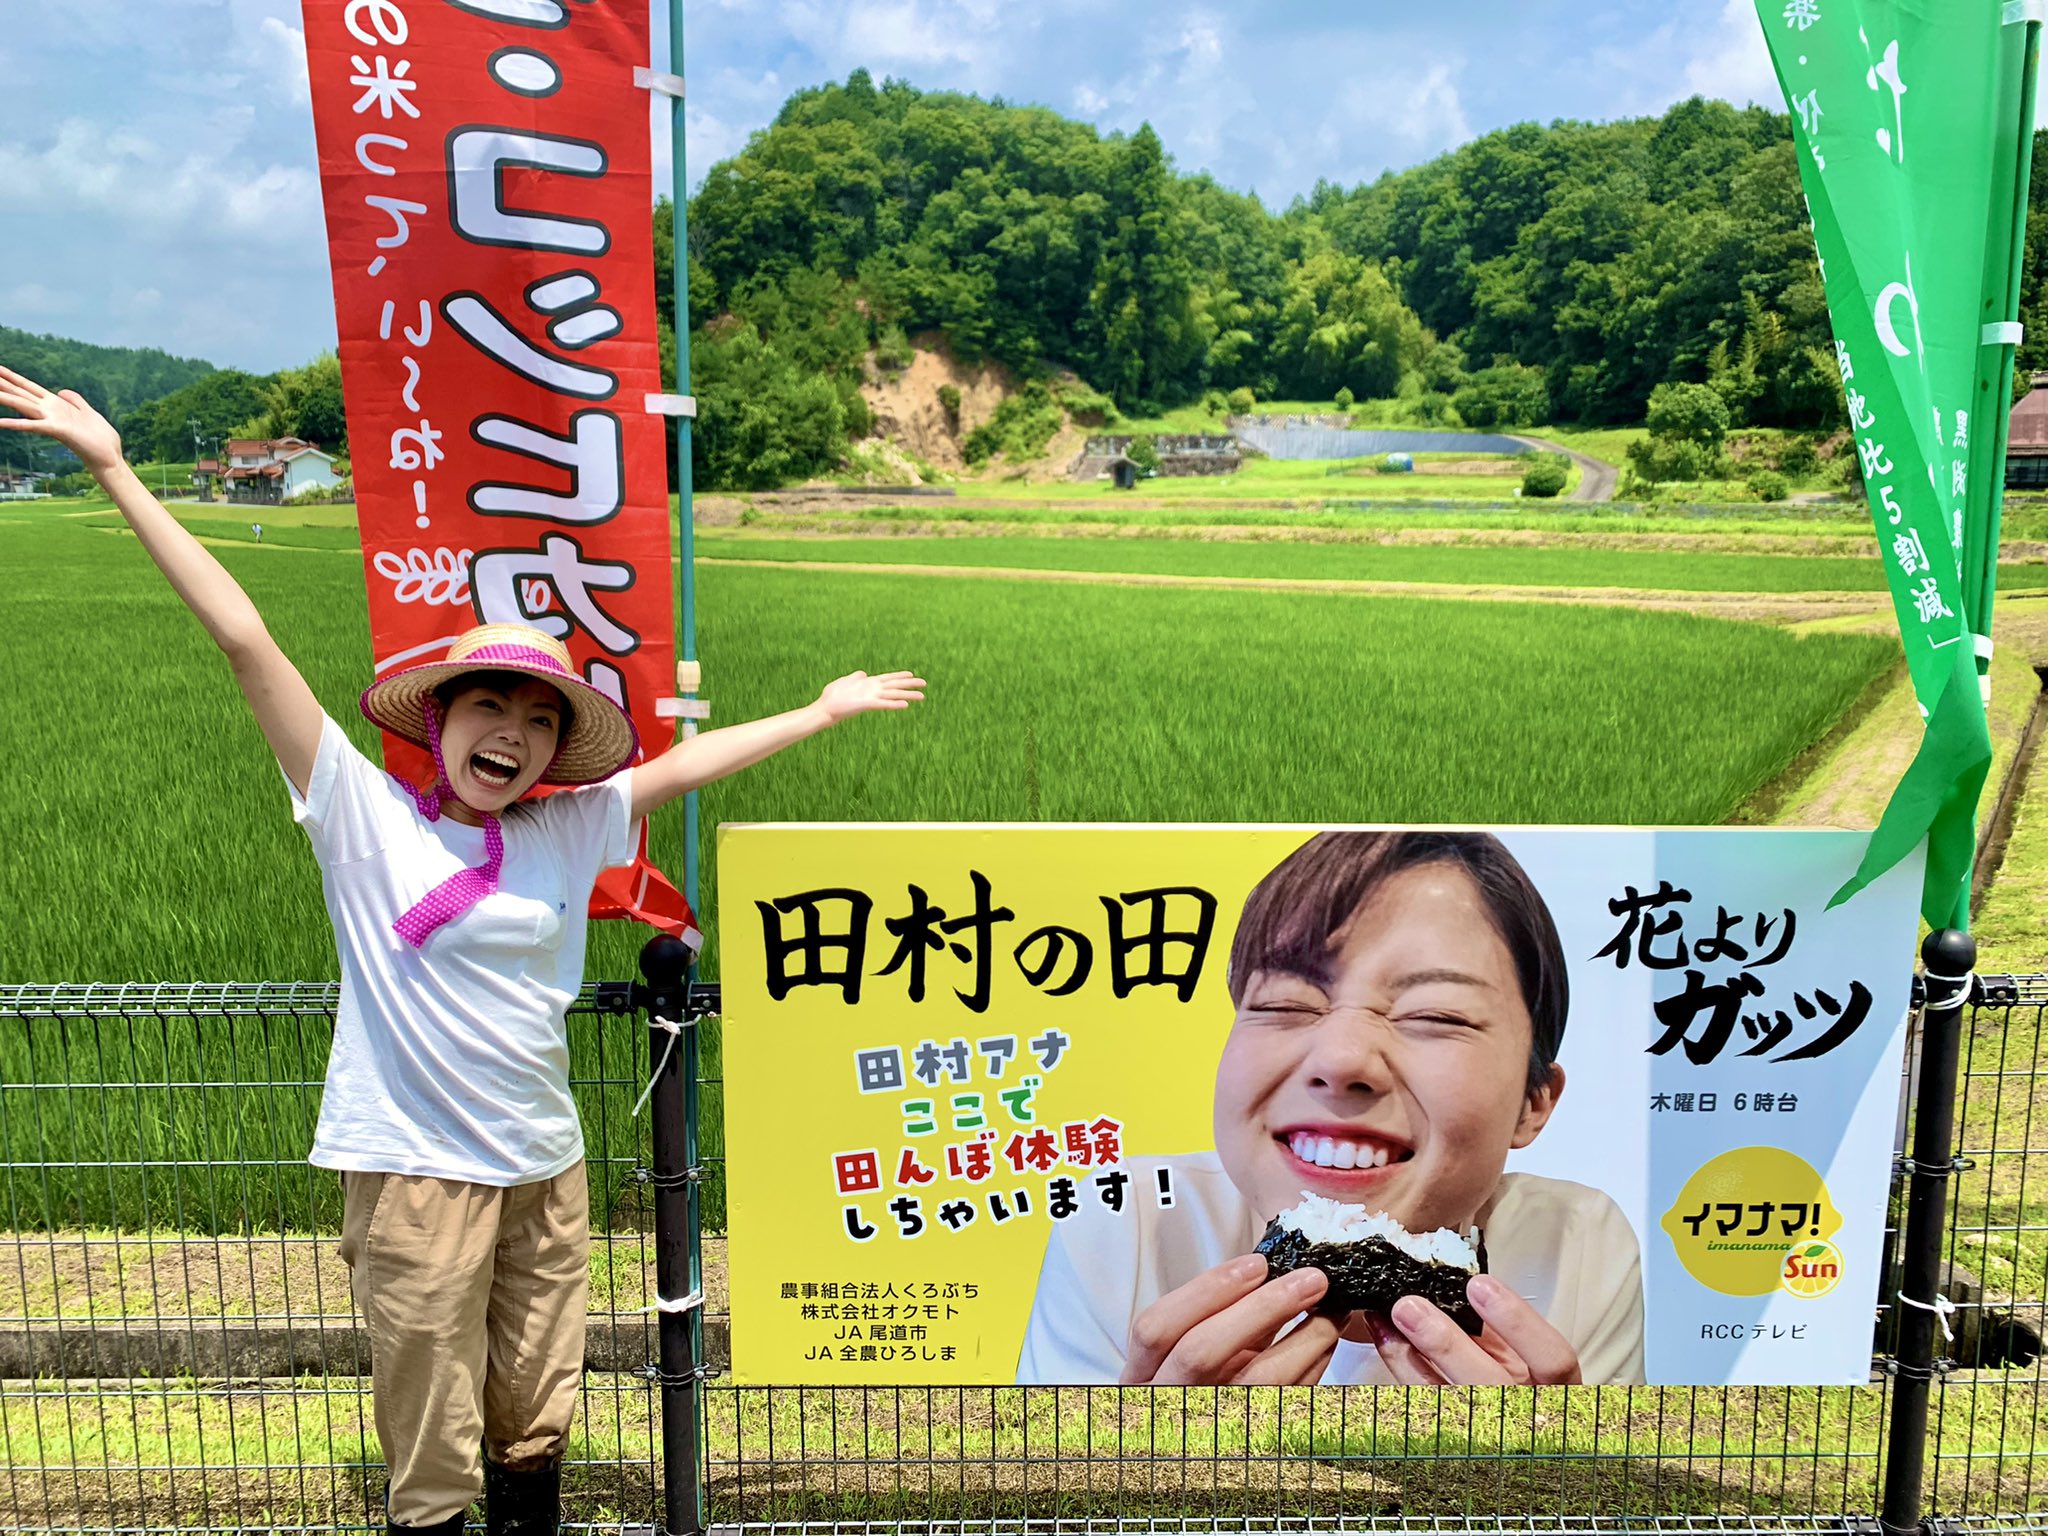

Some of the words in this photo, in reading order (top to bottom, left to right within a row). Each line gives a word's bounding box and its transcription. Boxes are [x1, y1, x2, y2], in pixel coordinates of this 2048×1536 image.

[1587, 880, 1797, 970] 花より
[754, 869, 1218, 1014] 田村の田
[1644, 969, 1873, 1066] ガッツ
[855, 1030, 1070, 1091] 田村アナ
[903, 1078, 1039, 1134] ここで
[1649, 1092, 1717, 1113] 木曜日
[1733, 1092, 1799, 1113] 6時台
[834, 1118, 1125, 1194] 田んぼ体験
[845, 1168, 1175, 1239] しちゃいます!
[1682, 1201, 1822, 1237] イマナマ!
[1706, 1240, 1792, 1252] imanama
[1784, 1254, 1838, 1279] Sun
[780, 1282, 979, 1300] 農事組合法人くろぶち
[800, 1303, 960, 1321] 株式会社オクモト
[834, 1325, 863, 1341] JA
[869, 1324, 928, 1341] 尾道市
[1701, 1324, 1744, 1340] RCC
[1751, 1324, 1807, 1340] テレビ
[804, 1345, 833, 1361] JA
[839, 1344, 957, 1362] 全農ひろしま
